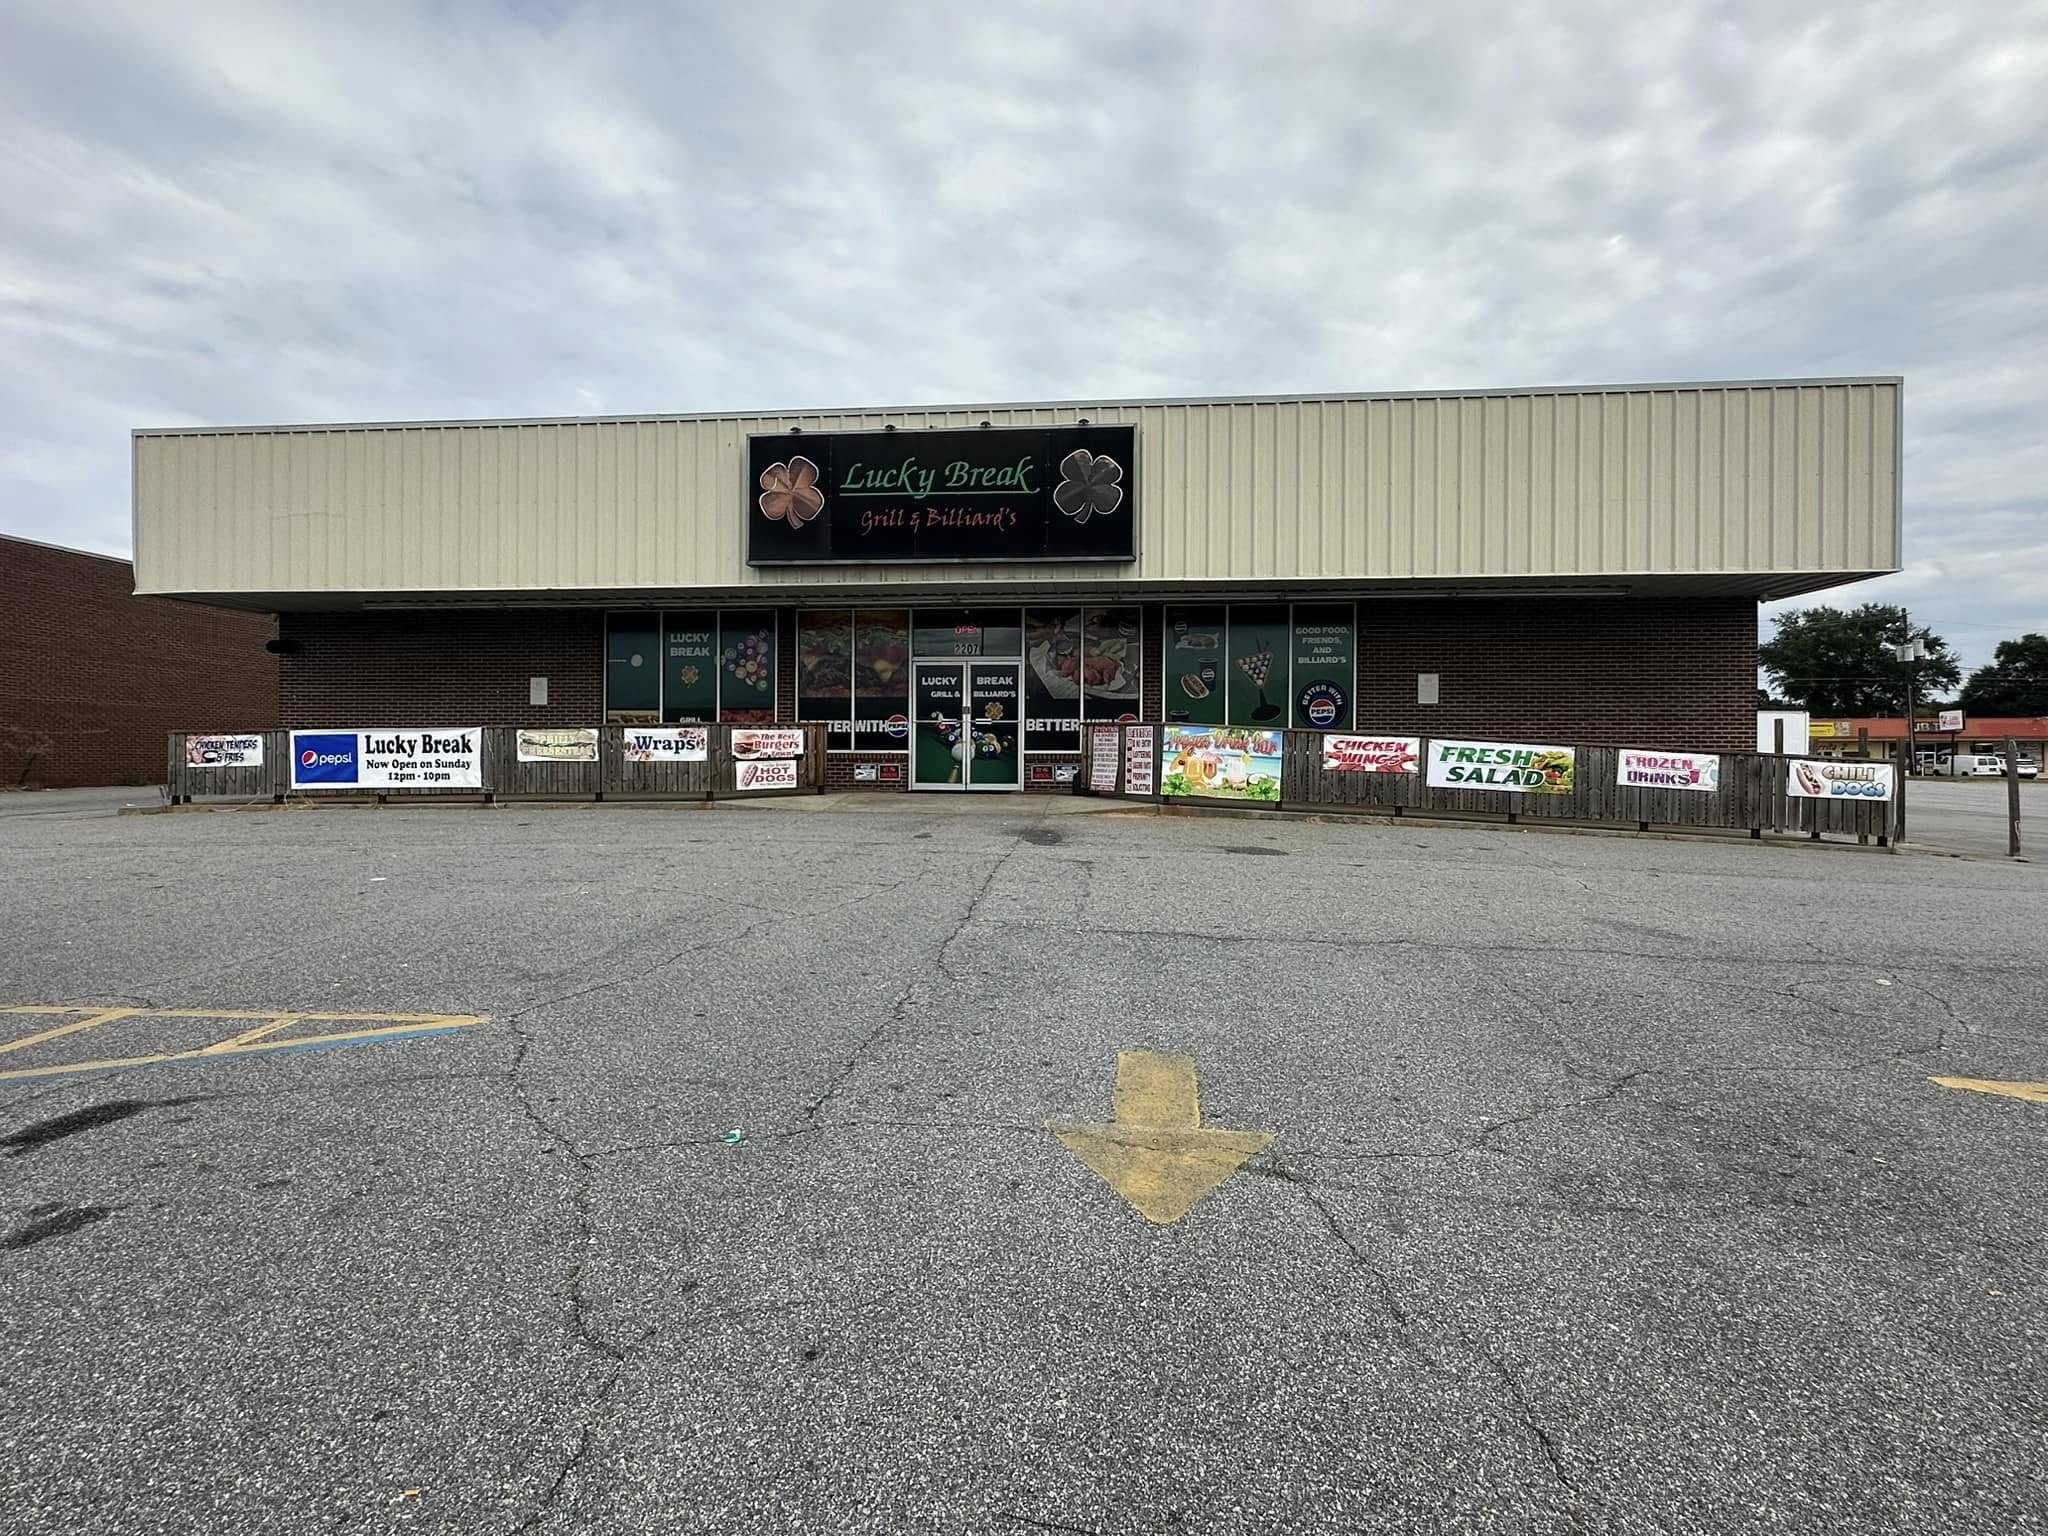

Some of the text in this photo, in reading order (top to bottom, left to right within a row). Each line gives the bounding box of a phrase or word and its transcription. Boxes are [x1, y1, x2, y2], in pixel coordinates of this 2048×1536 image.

[840, 456, 1040, 498] Lucky Break
[860, 507, 1017, 535] Grill & Billiard's
[1295, 626, 1350, 635] GOOD FOOD,
[670, 633, 710, 643] LUCKY
[1302, 637, 1343, 645] FRIENDS,
[670, 647, 710, 657] BREAK
[954, 643, 979, 655] 2207
[1312, 646, 1332, 654] AND
[1297, 656, 1347, 664] BILLIARD'S
[921, 676, 1014, 686] LUCKY BREAK
[930, 690, 1016, 698] GRILL & BILLIARD'S
[1302, 684, 1343, 706] BETTER WITH
[855, 719, 888, 733] WITH
[1025, 718, 1081, 732] BETTER
[760, 733, 776, 741] The
[195, 739, 258, 750] CHICKEN TENDERS
[364, 734, 473, 758] Lucky Break
[634, 735, 697, 754] Wraps
[754, 740, 800, 751] Burgers
[1332, 740, 1408, 753] CHICKEN
[224, 752, 245, 762] FRIES
[319, 753, 353, 766] pepsi
[1339, 752, 1402, 766] WINGS
[1439, 746, 1535, 767] FRESH
[1625, 755, 1694, 770] FROZEN
[366, 759, 472, 770] Now Open on Sunday
[760, 766, 790, 775] HOT
[388, 772, 415, 782] 12pm
[423, 772, 450, 782] 10pm
[755, 774, 796, 783] DOGS
[1445, 766, 1546, 787] SALAD
[1626, 769, 1691, 786] DRINKS
[1822, 765, 1876, 782] CHILI
[1831, 780, 1886, 798] DOGS
